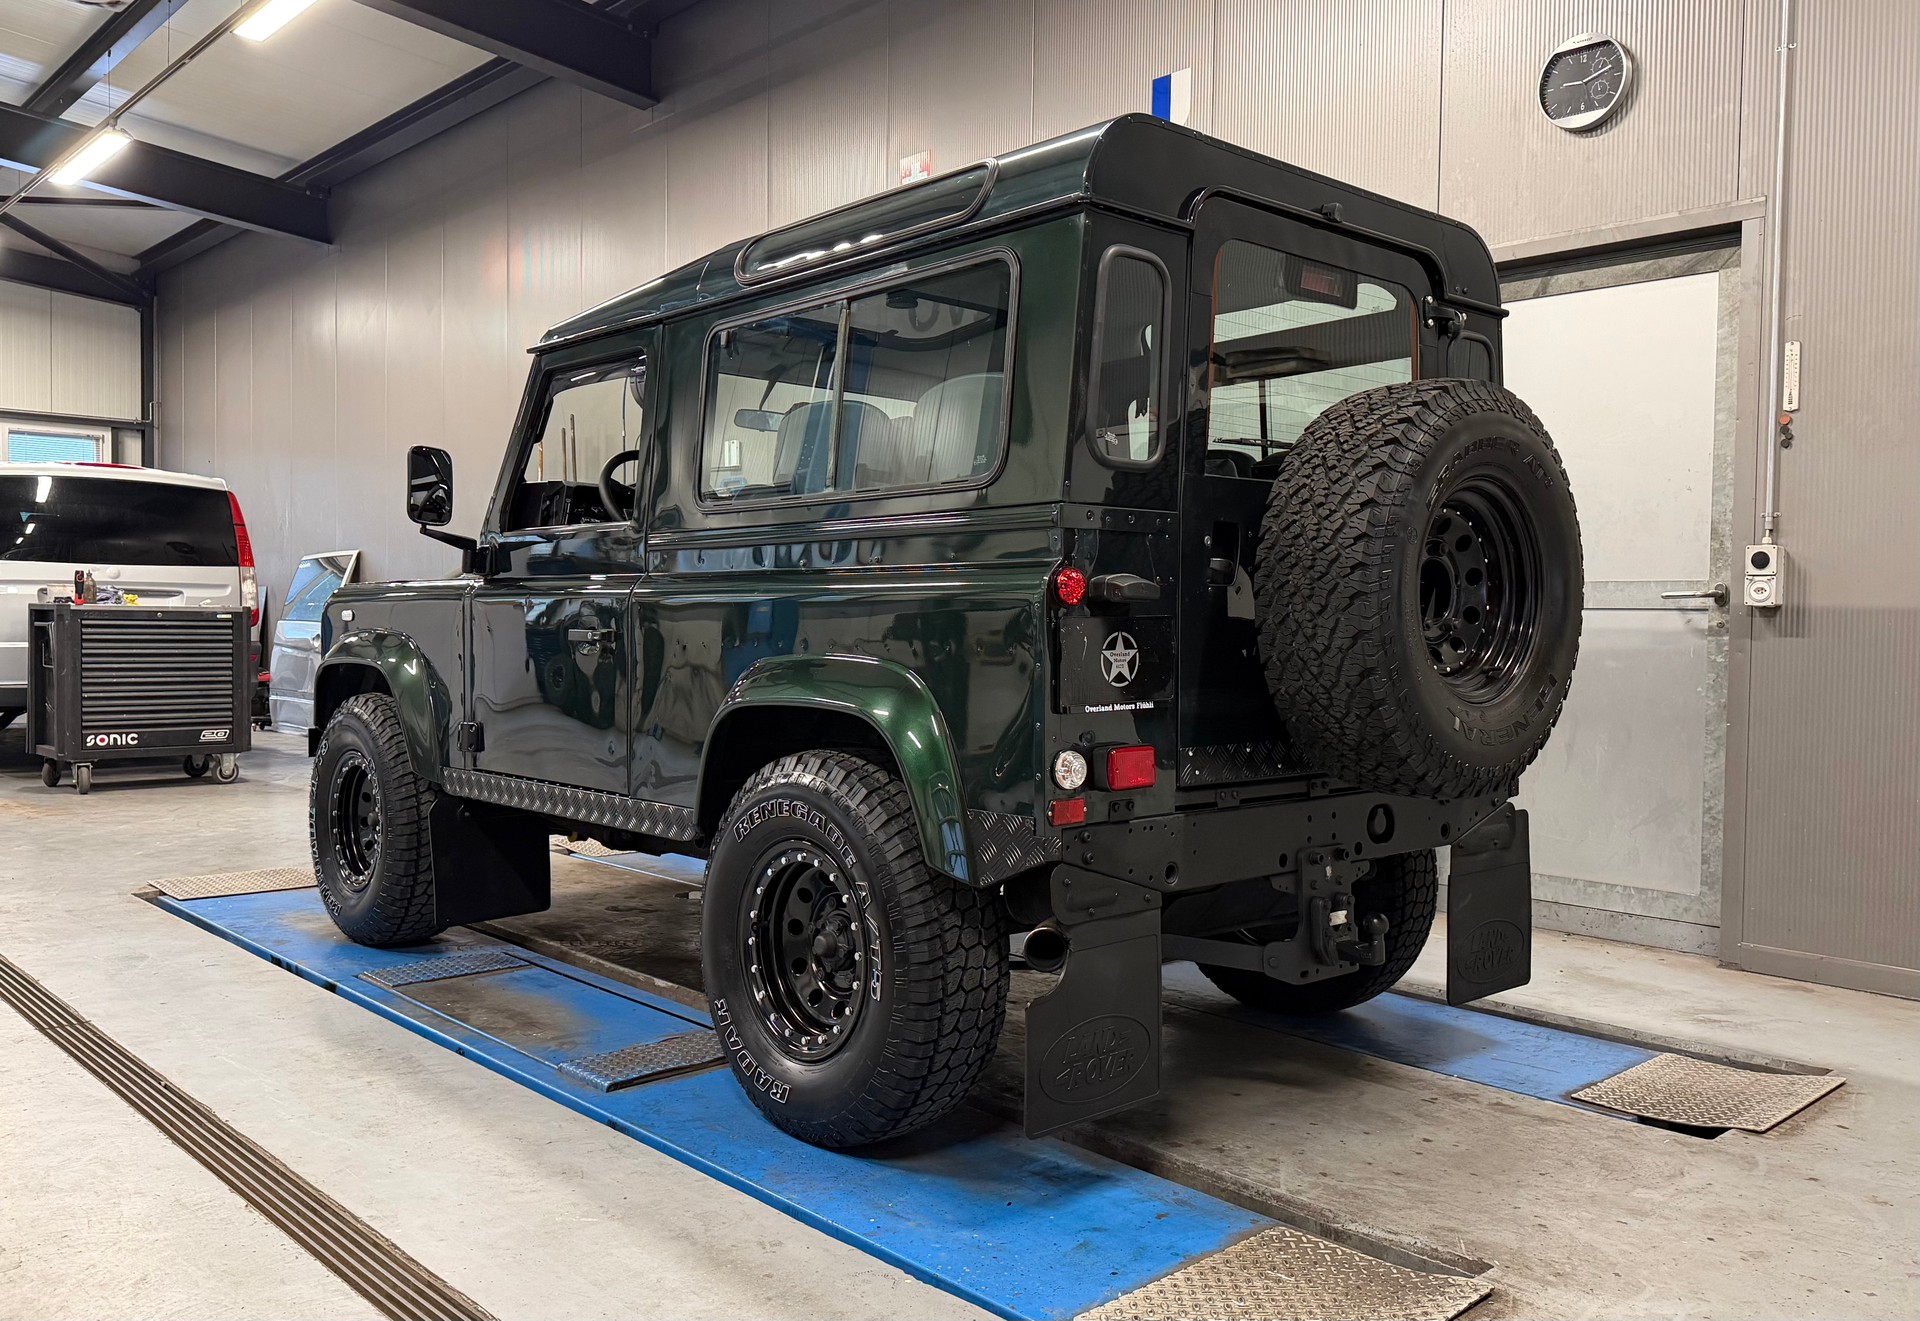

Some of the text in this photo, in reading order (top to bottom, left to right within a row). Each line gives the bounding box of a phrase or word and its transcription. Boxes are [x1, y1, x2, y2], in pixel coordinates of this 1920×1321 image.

[1580, 54, 1588, 63] 12
[1580, 102, 1585, 110] 6
[1085, 704, 1113, 713] Overland
[1114, 703, 1135, 711] Motors
[733, 798, 858, 868] RENEGADE
[713, 998, 792, 1104] RADAR
